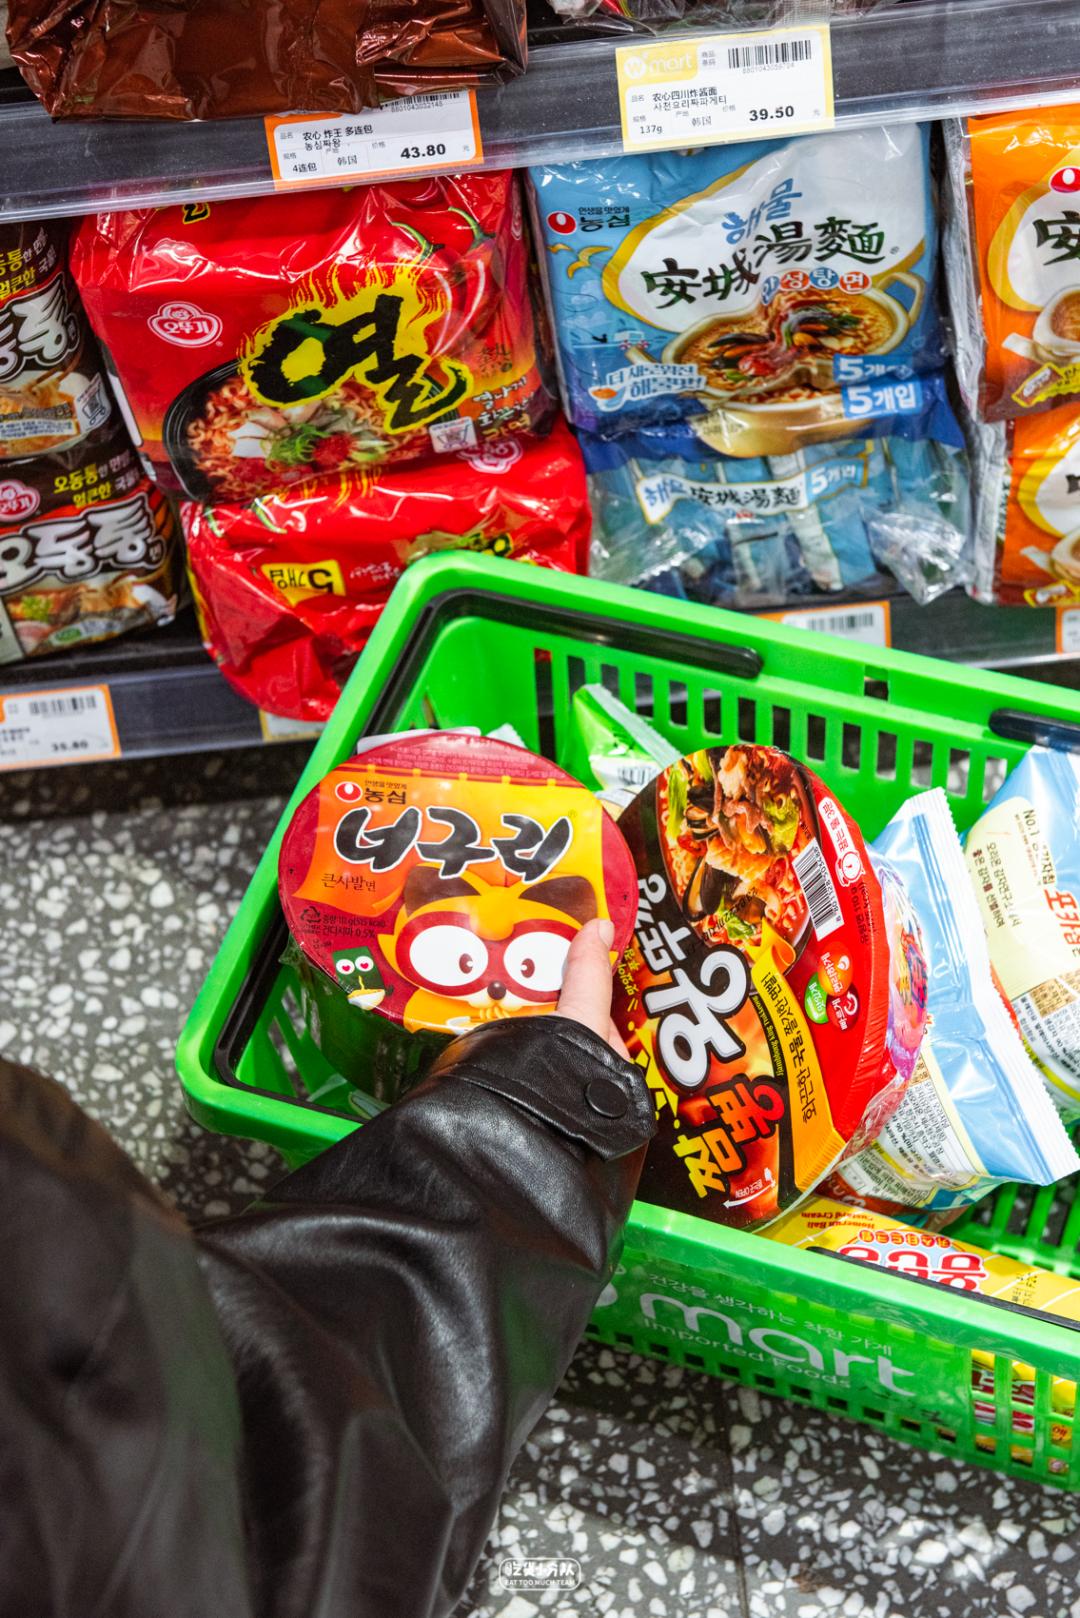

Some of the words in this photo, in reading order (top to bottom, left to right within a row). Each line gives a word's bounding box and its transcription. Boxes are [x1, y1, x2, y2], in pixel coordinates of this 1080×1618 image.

[691, 116, 712, 127] 韩国
[749, 105, 795, 122] 39.50
[302, 130, 321, 141] 农心
[323, 127, 343, 139] 炸王
[345, 124, 374, 136] 多连包
[640, 125, 663, 135] 137g
[337, 154, 358, 166] 韩国
[400, 143, 446, 160] 43.80
[292, 162, 318, 173] 4连包
[579, 214, 630, 232] 농심
[640, 217, 886, 310] 安城湯麵
[762, 269, 870, 305] 안성탕면
[847, 381, 917, 415] 5개입
[809, 465, 856, 496] 5개입
[364, 787, 407, 805] 농심
[334, 806, 573, 884] 너구리
[321, 872, 377, 892] 큰사발면
[820, 952, 843, 993] 편리하게
[760, 971, 782, 1001] 면발!
[831, 998, 849, 1031] 빠르게
[797, 1067, 818, 1123] 화끈한
[673, 1082, 785, 1199] 짬뽕
[801, 1211, 833, 1221] Cream
[806, 1221, 828, 1230] Ball
[639, 1292, 916, 1398] mart
[643, 1318, 766, 1363] Imported
[773, 1357, 851, 1389] Foods
[850, 1336, 894, 1356] 가게
